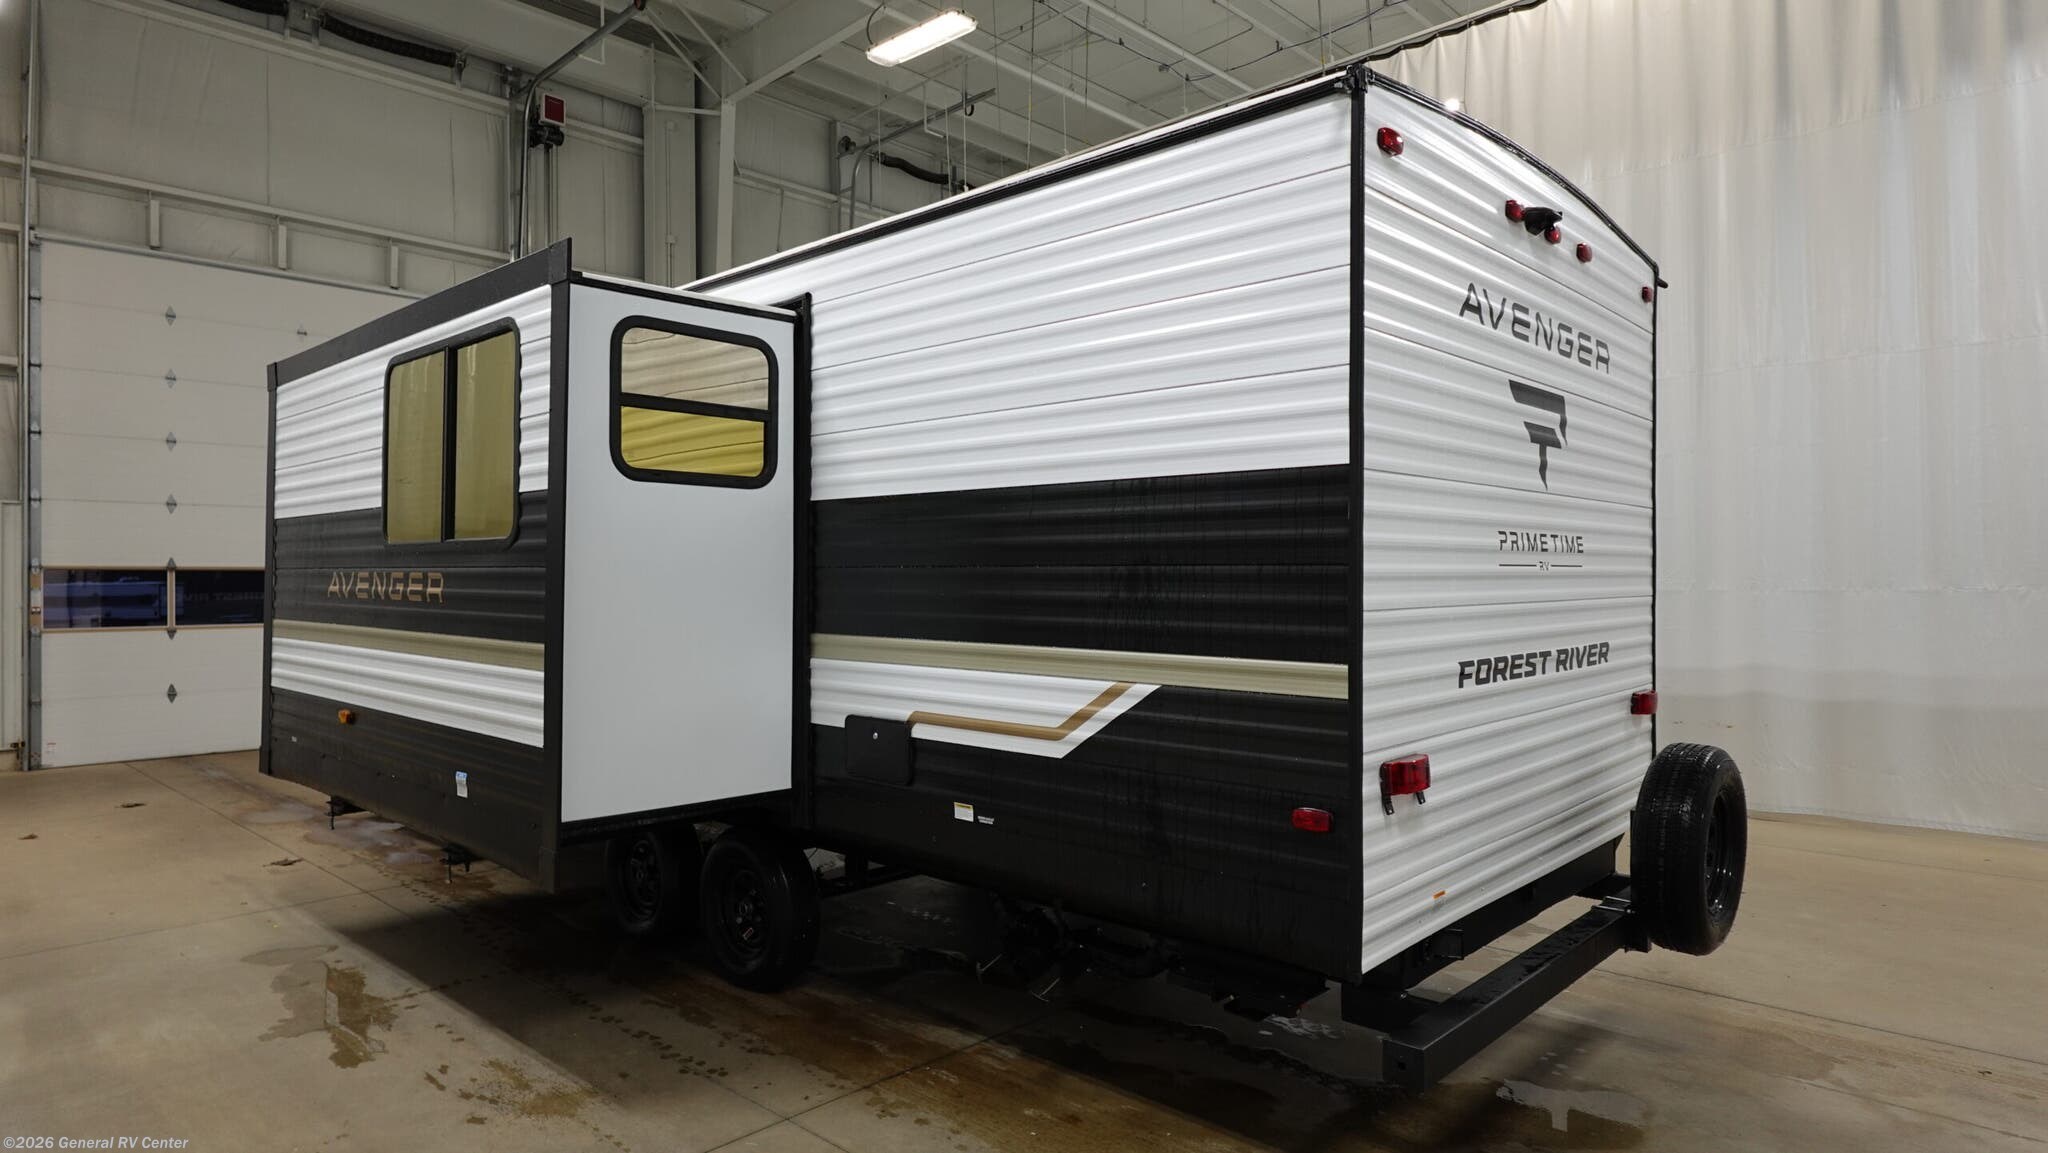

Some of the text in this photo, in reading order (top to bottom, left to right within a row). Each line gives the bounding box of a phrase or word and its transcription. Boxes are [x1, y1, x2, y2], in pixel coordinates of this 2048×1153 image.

[1458, 282, 1611, 375] AVENGER
[1497, 530, 1584, 554] PRIMETIME
[1539, 561, 1550, 572] RV
[327, 571, 445, 604] AVENGER
[1458, 641, 1611, 689] FOREST RIVER
